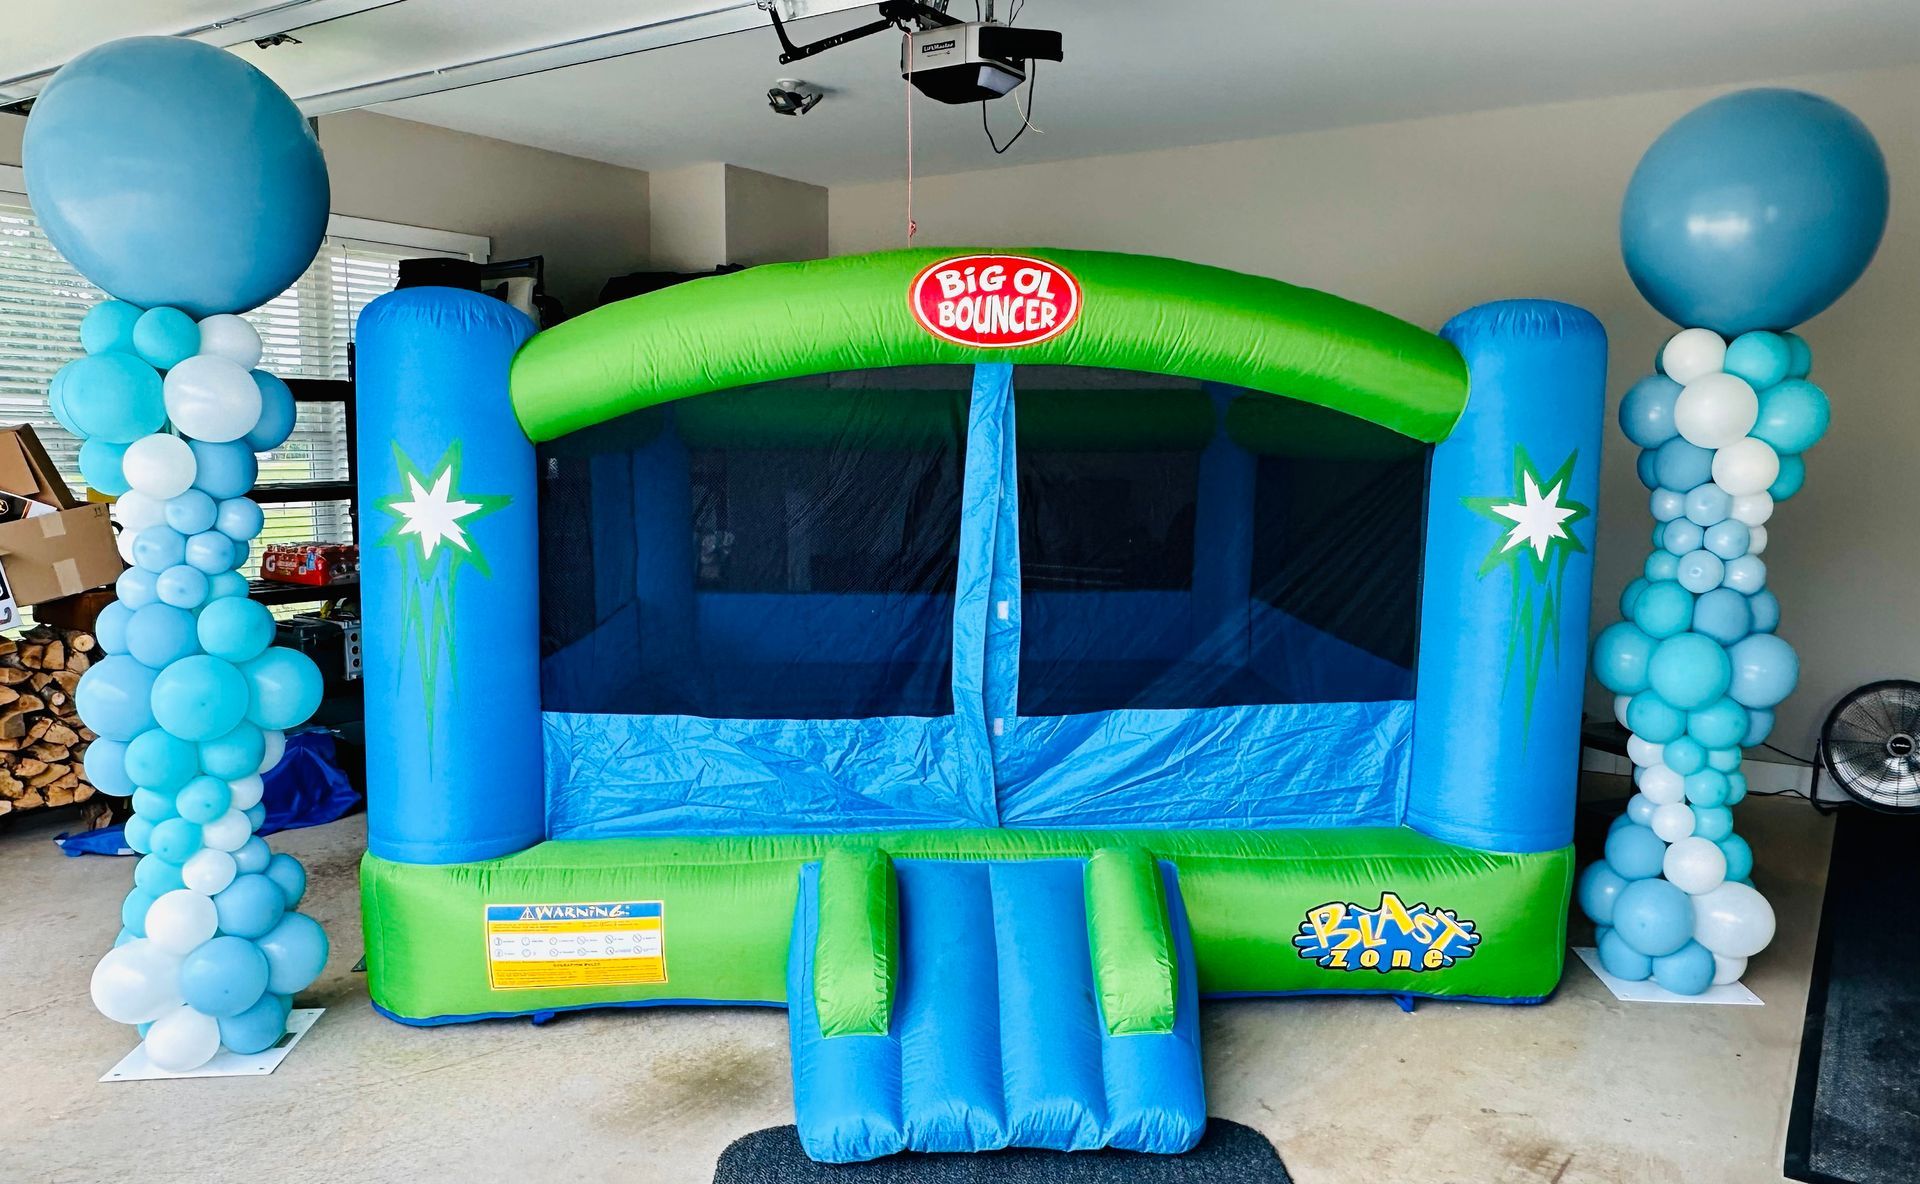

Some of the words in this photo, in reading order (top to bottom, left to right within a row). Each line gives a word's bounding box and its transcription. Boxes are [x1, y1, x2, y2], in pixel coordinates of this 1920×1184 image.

[1013, 267, 1056, 300] OL
[937, 294, 1058, 335] BOUNCER
[265, 554, 276, 572] G
[1307, 893, 1472, 950] BLAST
[1328, 948, 1444, 968] zone
